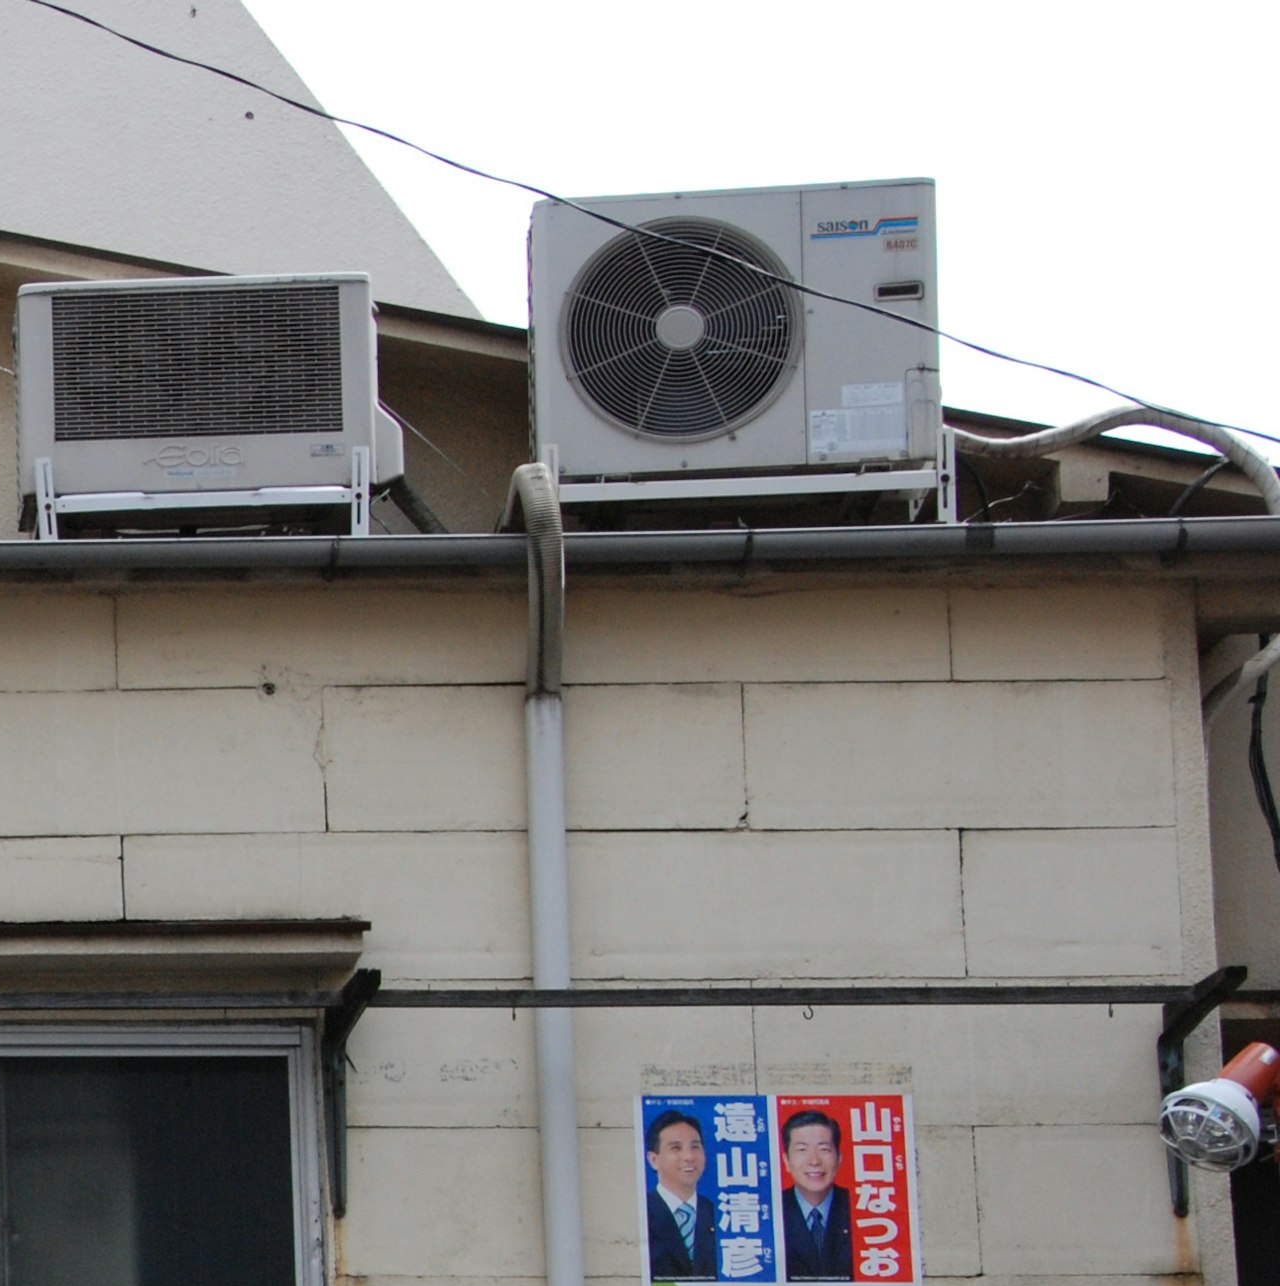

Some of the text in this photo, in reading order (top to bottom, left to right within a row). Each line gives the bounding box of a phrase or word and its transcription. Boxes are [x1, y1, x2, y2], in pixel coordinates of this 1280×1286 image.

[714, 1102, 764, 1278] 遠山清彦
[850, 1102, 900, 1277] 山口なつお
